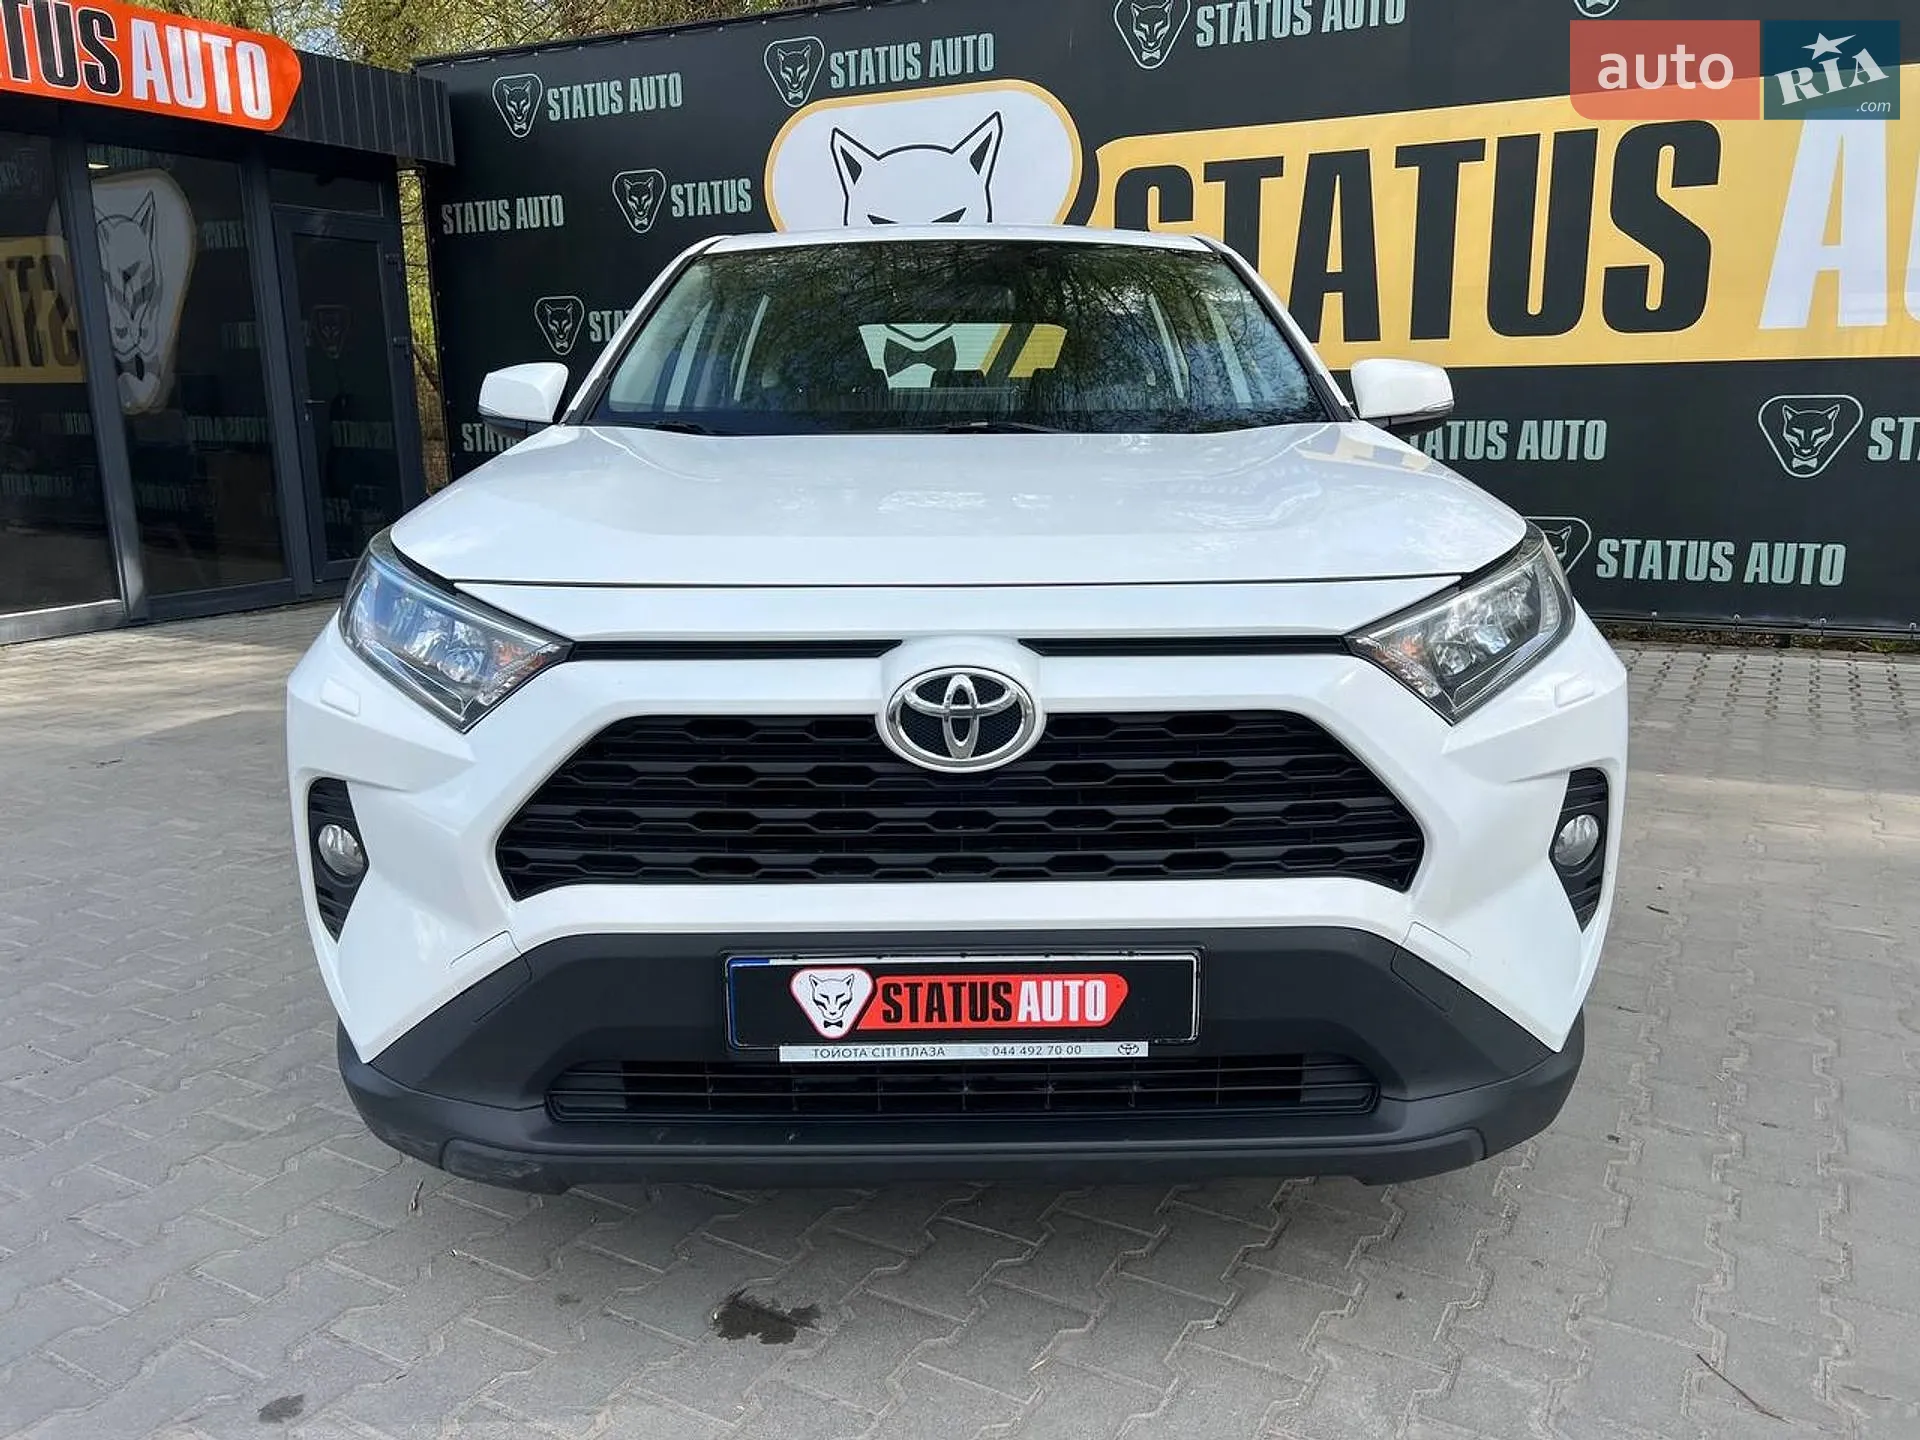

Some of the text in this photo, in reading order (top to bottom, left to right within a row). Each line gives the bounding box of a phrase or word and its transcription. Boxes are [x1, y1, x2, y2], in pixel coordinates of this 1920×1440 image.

[1196, 0, 1406, 48] STATUS AUTO
[131, 18, 272, 120] AUTO
[829, 32, 995, 89] STATUS AUTO
[547, 72, 683, 121] STATUS AUTO
[442, 194, 564, 234] STATUS AUTO
[671, 178, 752, 218] STATUS
[1758, 106, 1920, 330] A
[588, 310, 631, 342] STA
[461, 422, 520, 452] STA
[1410, 420, 1608, 460] ATUS AUTO
[1868, 416, 1920, 461] ST
[1597, 539, 1847, 586] STATUS AUTO
[882, 980, 1107, 1023] STATUS AUTO
[814, 1047, 868, 1059] ТОЙОТА
[901, 1046, 946, 1057] ПЛАЗА
[992, 1045, 1015, 1056] 044
[1019, 1045, 1043, 1056] 492
[1048, 1045, 1063, 1056] 70
[1067, 1044, 1082, 1055] 00
